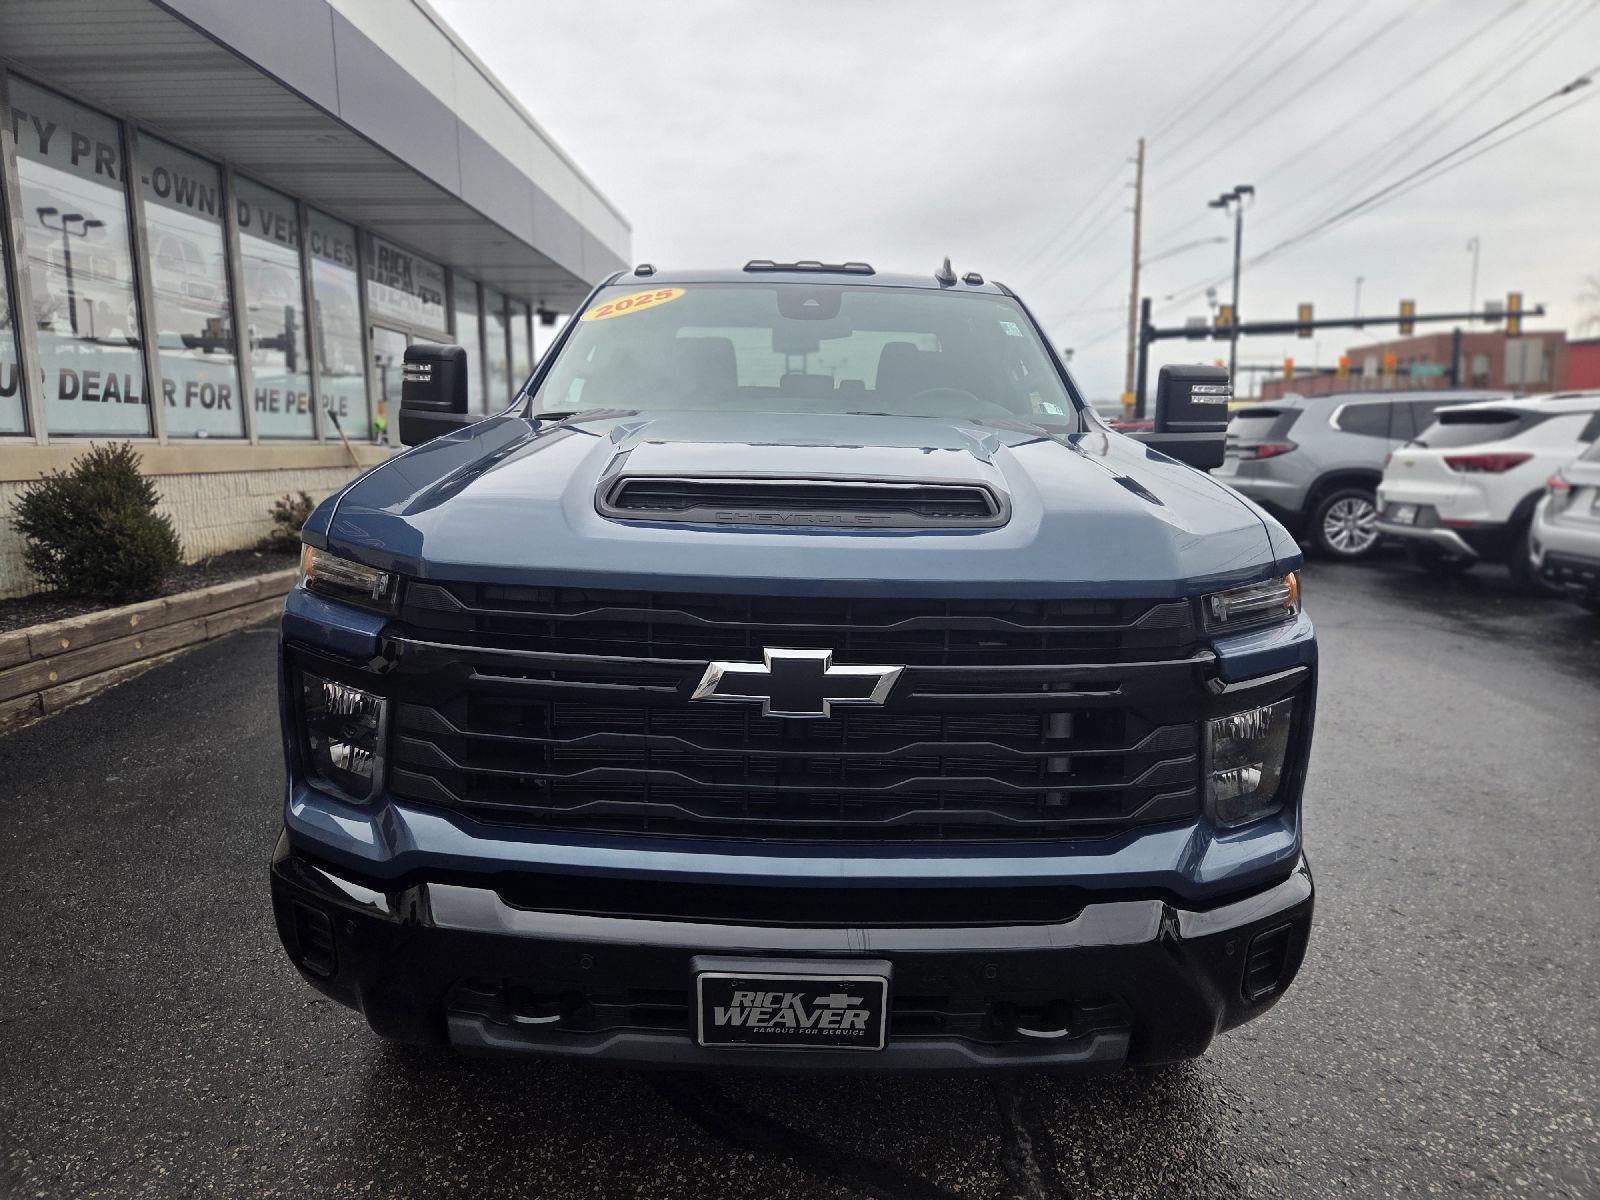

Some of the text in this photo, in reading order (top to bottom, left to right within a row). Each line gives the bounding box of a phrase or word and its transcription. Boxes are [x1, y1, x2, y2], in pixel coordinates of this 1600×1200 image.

[71, 131, 250, 228] PR-OWND
[259, 207, 353, 267] VEHCLES
[595, 289, 673, 318] 2025
[58, 368, 177, 408] DEALR
[185, 381, 232, 410] FOR
[255, 387, 280, 414] HE
[715, 511, 892, 524] CHEVROLET
[730, 990, 805, 1010] RICK
[713, 1006, 871, 1029] WEAVER
